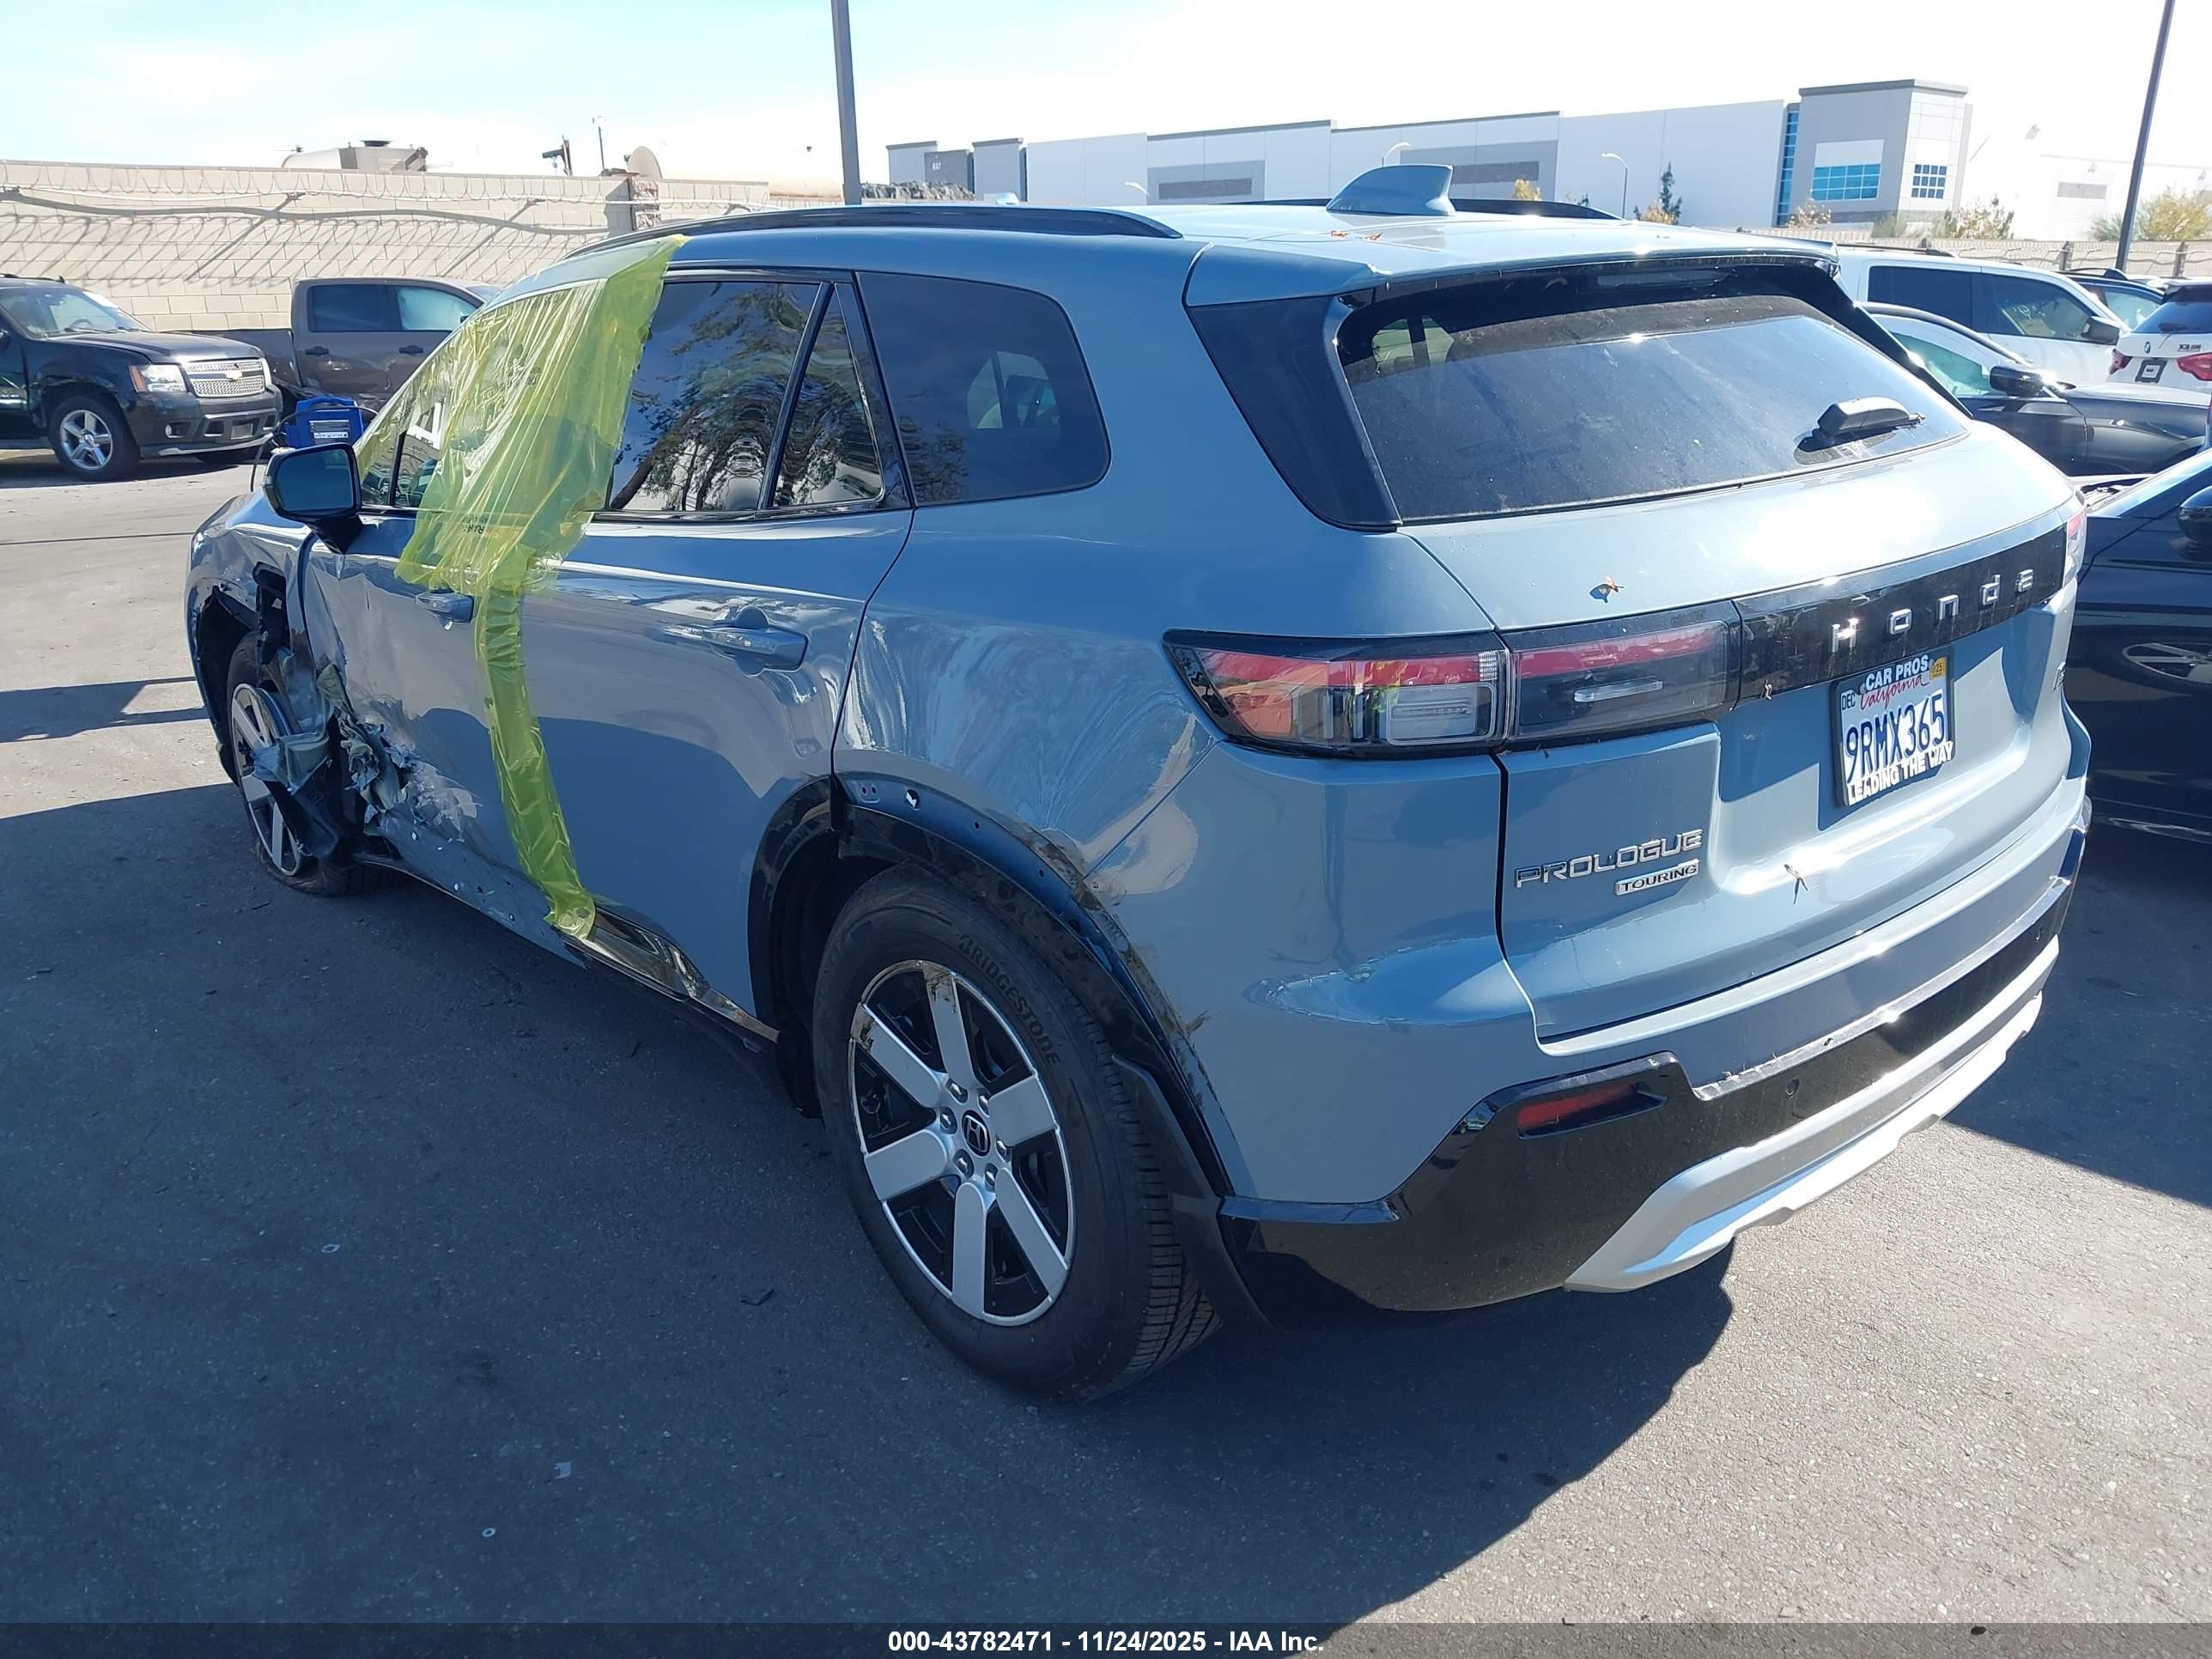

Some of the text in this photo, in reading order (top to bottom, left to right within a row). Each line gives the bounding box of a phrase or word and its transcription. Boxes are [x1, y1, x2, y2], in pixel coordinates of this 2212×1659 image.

[1865, 654, 1929, 691] CAR PROS
[1841, 691, 1856, 711] DEC
[1859, 673, 1930, 712] California
[1846, 692, 1946, 784] 9RMX365
[1847, 740, 1954, 806] LEADING THE WAY
[1516, 829, 1704, 888] PROLOGUE
[1620, 863, 1698, 892] TOURING
